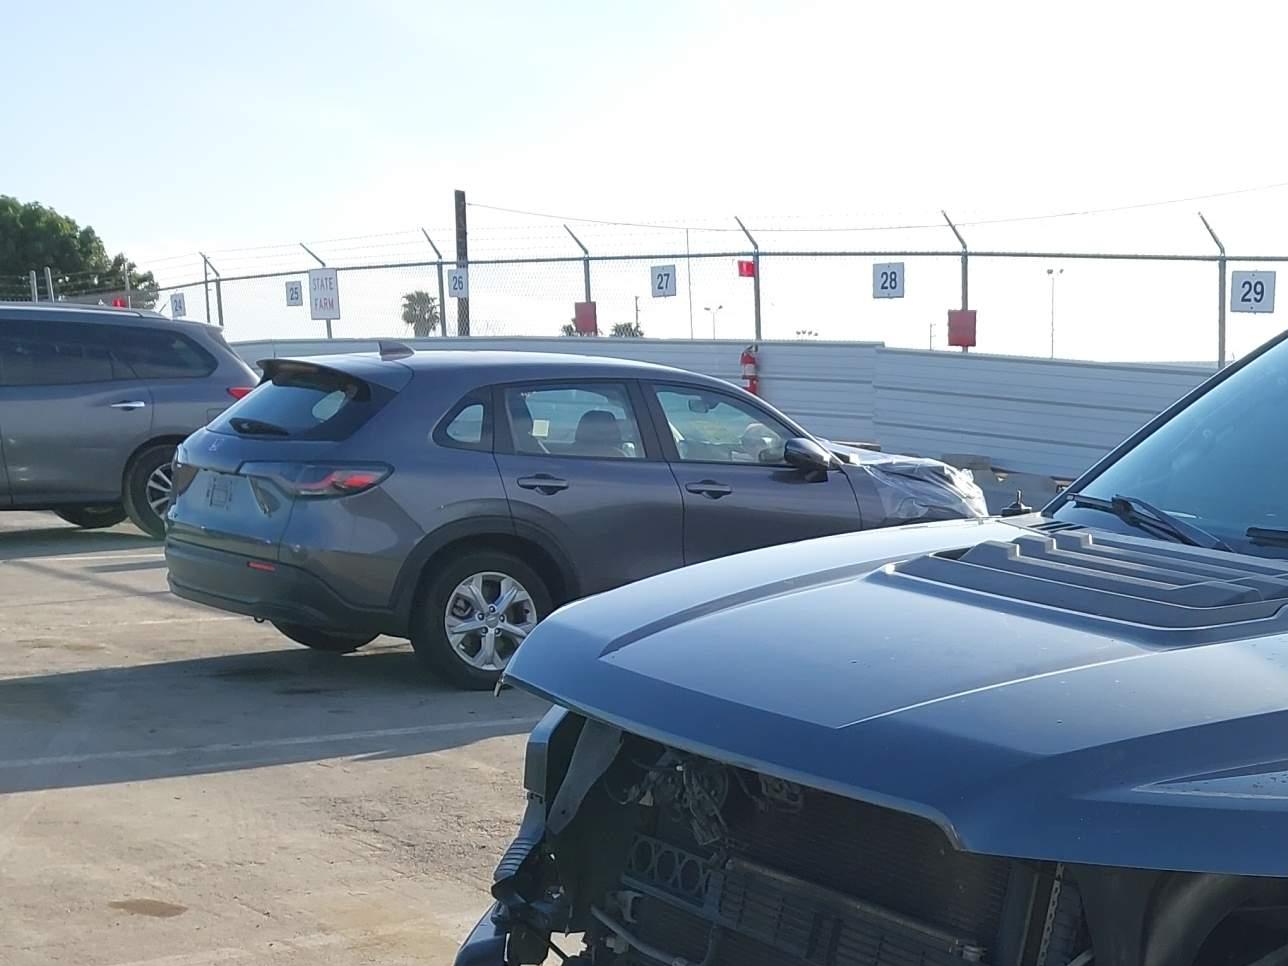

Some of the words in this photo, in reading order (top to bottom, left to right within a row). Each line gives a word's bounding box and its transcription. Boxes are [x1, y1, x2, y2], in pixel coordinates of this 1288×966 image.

[313, 277, 334, 291] STATE
[452, 275, 463, 290] 26
[656, 273, 670, 290] 27
[880, 271, 898, 290] 28
[289, 287, 299, 301] 25
[1240, 280, 1265, 303] 29
[315, 297, 334, 311] FARM
